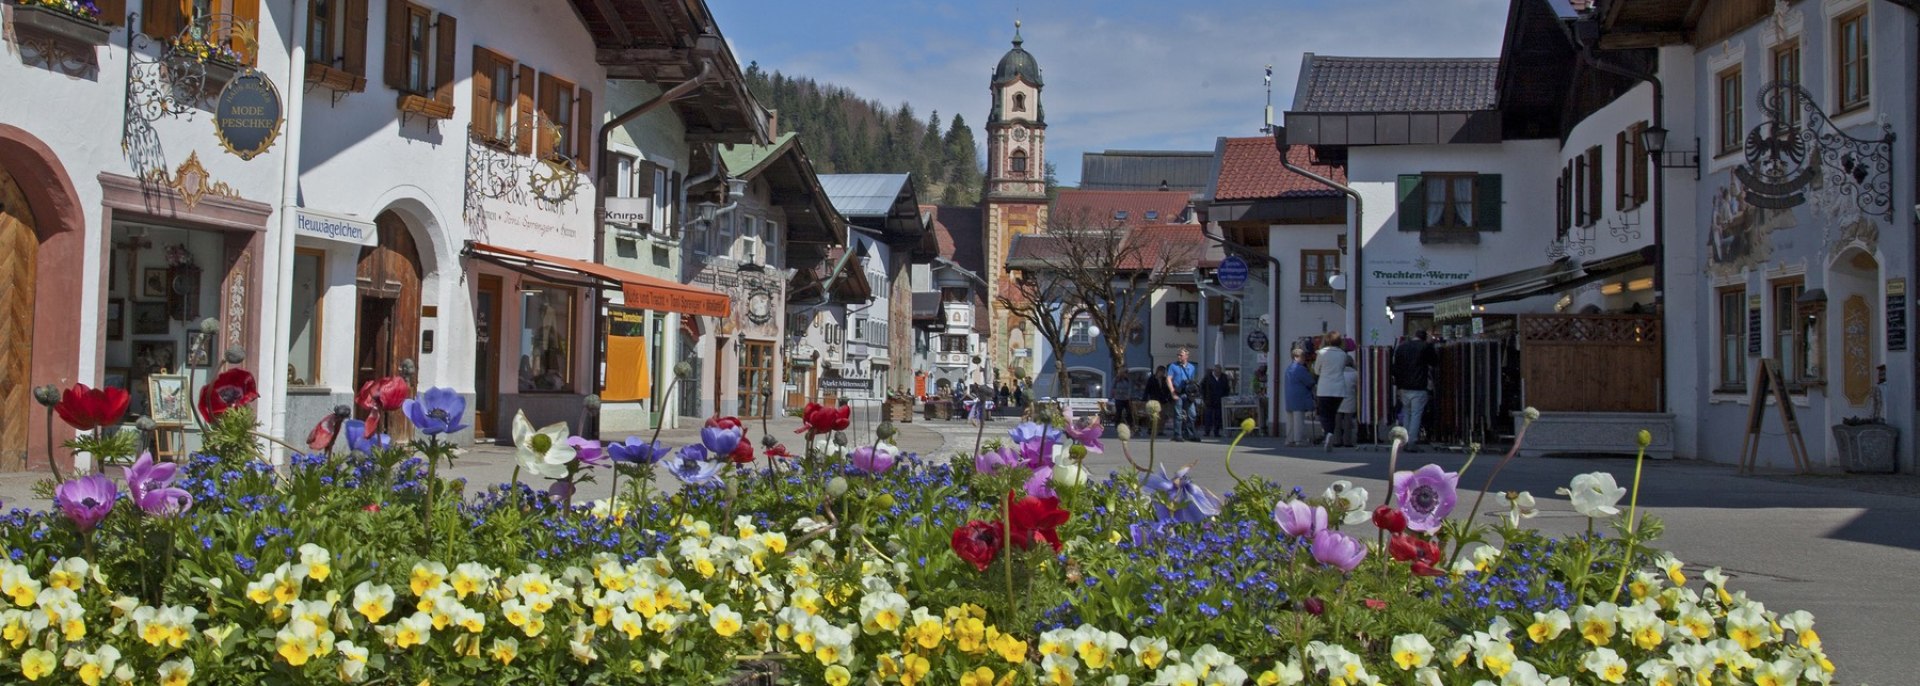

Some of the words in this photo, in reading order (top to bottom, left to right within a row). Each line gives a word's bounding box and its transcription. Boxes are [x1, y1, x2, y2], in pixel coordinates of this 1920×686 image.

[231, 106, 264, 115] MODE
[221, 118, 273, 129] PESCHKE
[605, 211, 644, 221] Knirps
[298, 214, 363, 239] Heuwägelchen
